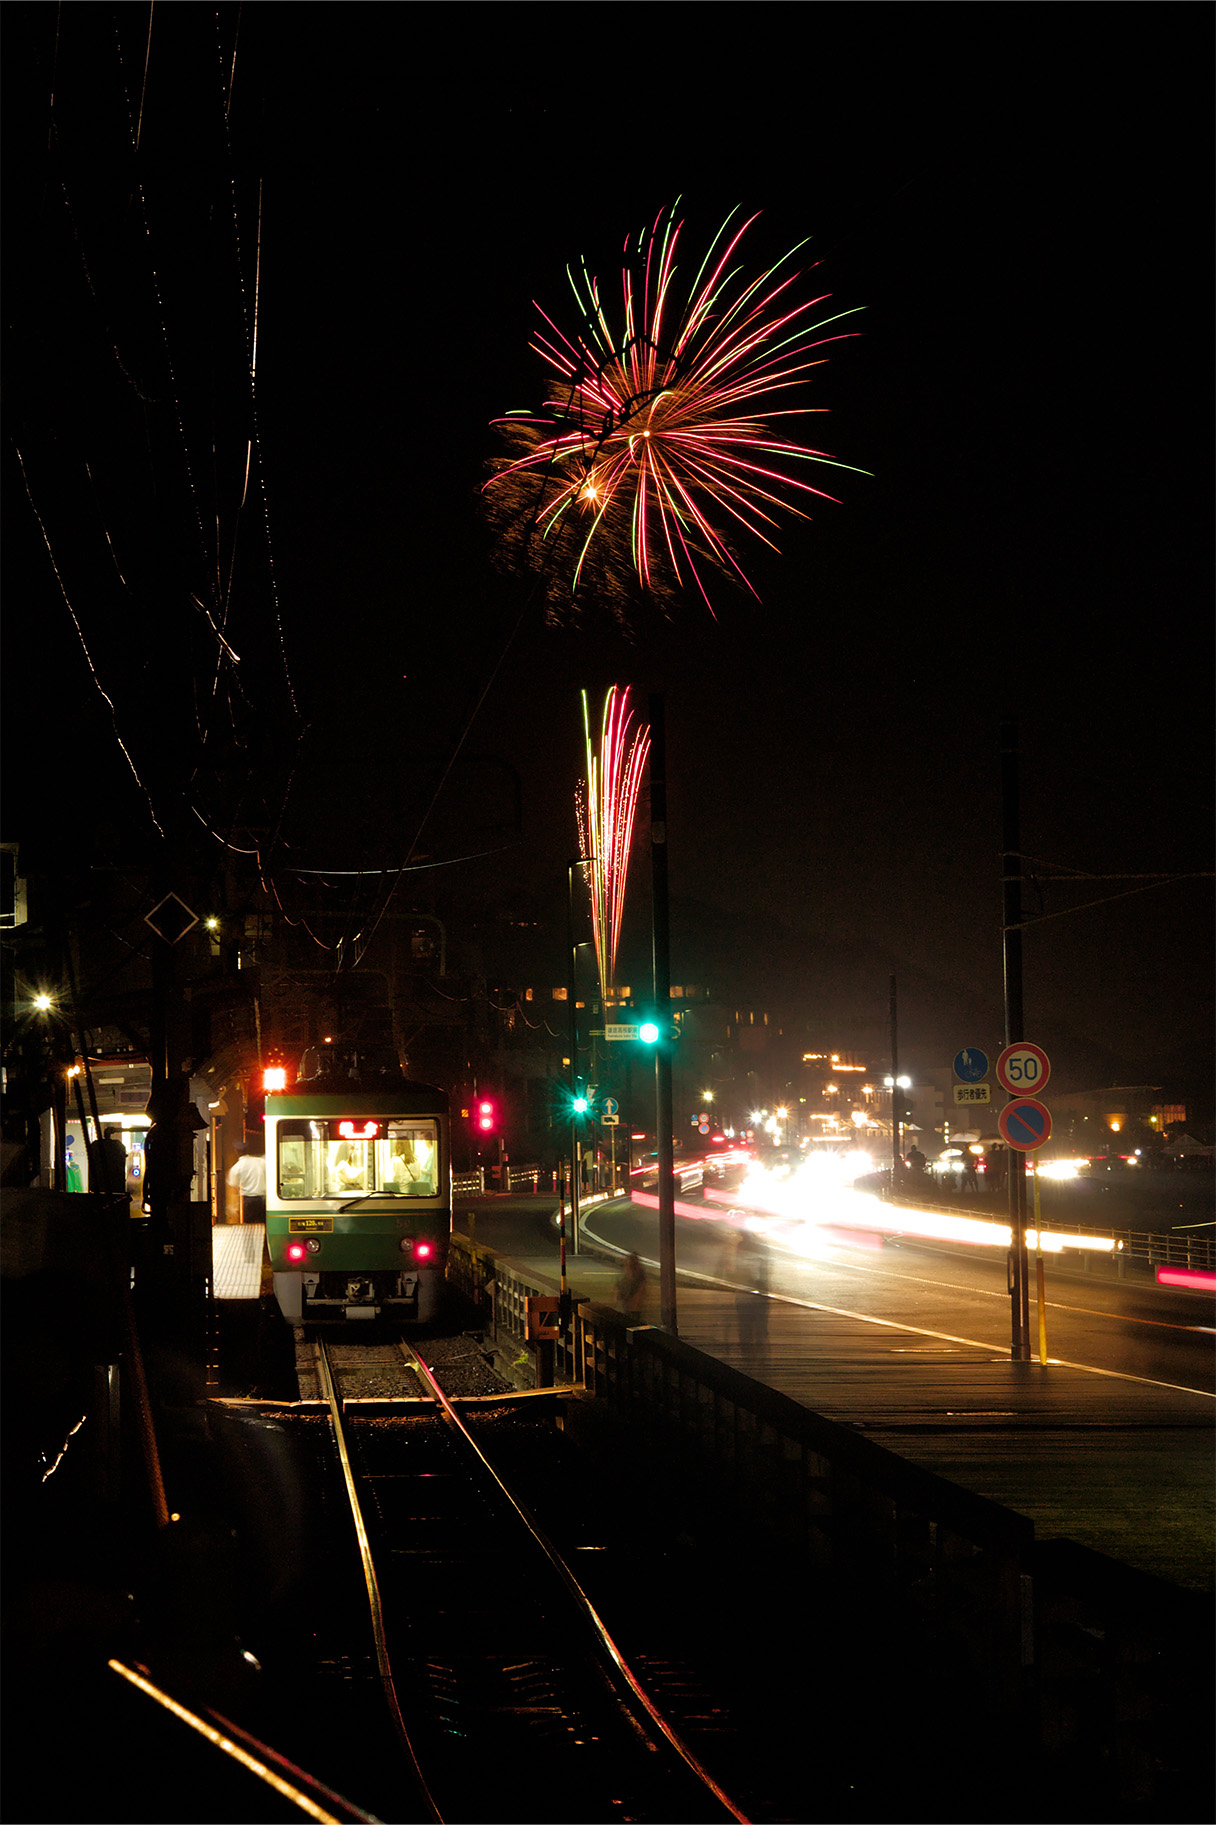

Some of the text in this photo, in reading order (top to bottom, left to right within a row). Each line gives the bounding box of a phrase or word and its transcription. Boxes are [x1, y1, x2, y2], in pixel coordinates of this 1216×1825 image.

[1009, 1058, 1037, 1081] 50
[957, 1088, 987, 1101] 歩行者優先
